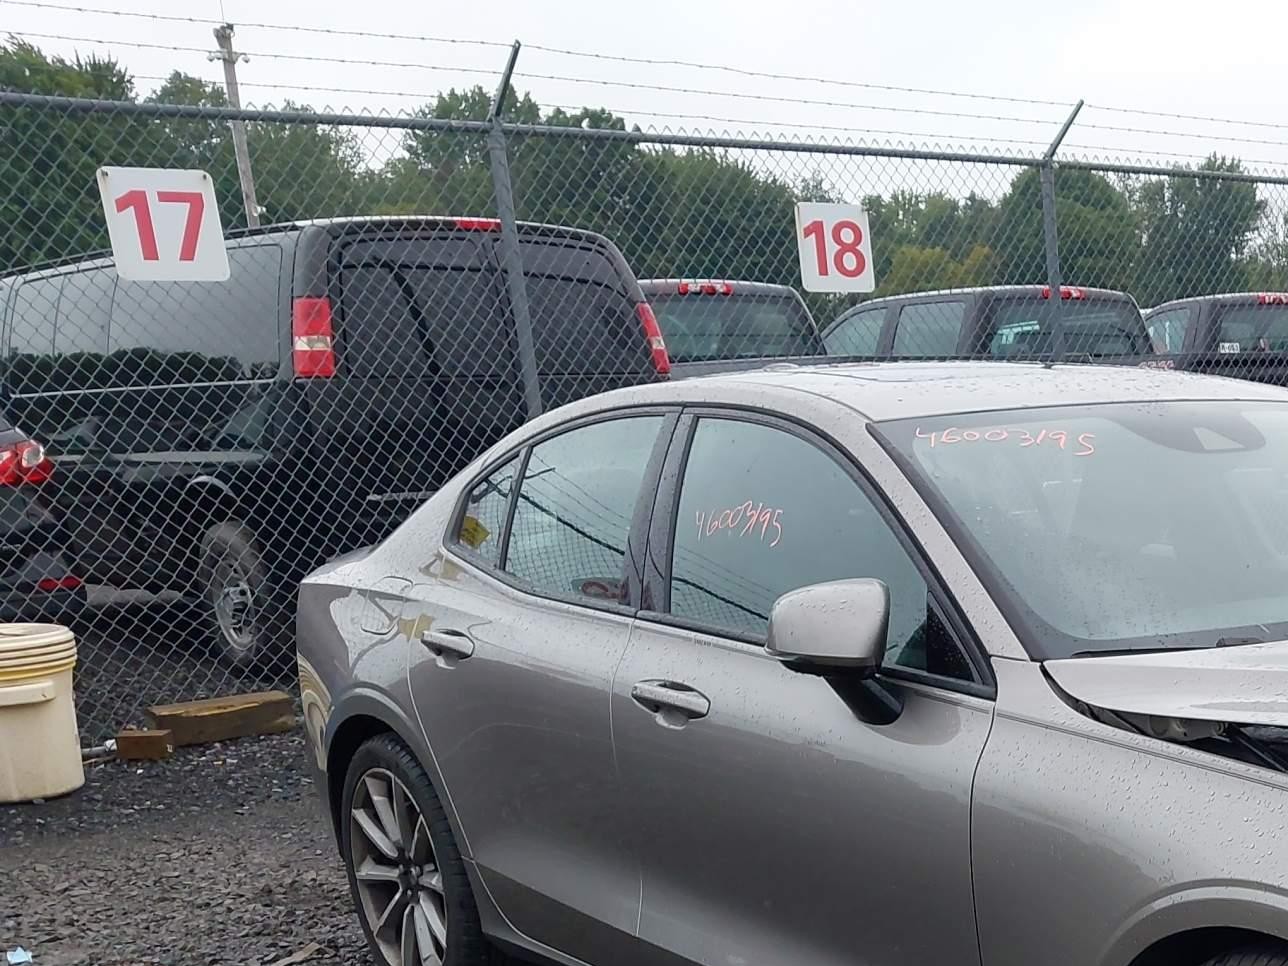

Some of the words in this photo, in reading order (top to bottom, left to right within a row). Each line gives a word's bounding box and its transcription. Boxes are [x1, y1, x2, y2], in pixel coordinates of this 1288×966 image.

[114, 189, 205, 262] 17
[803, 219, 867, 278] 18
[915, 427, 1096, 456] 46003195
[695, 500, 784, 547] 46003195
